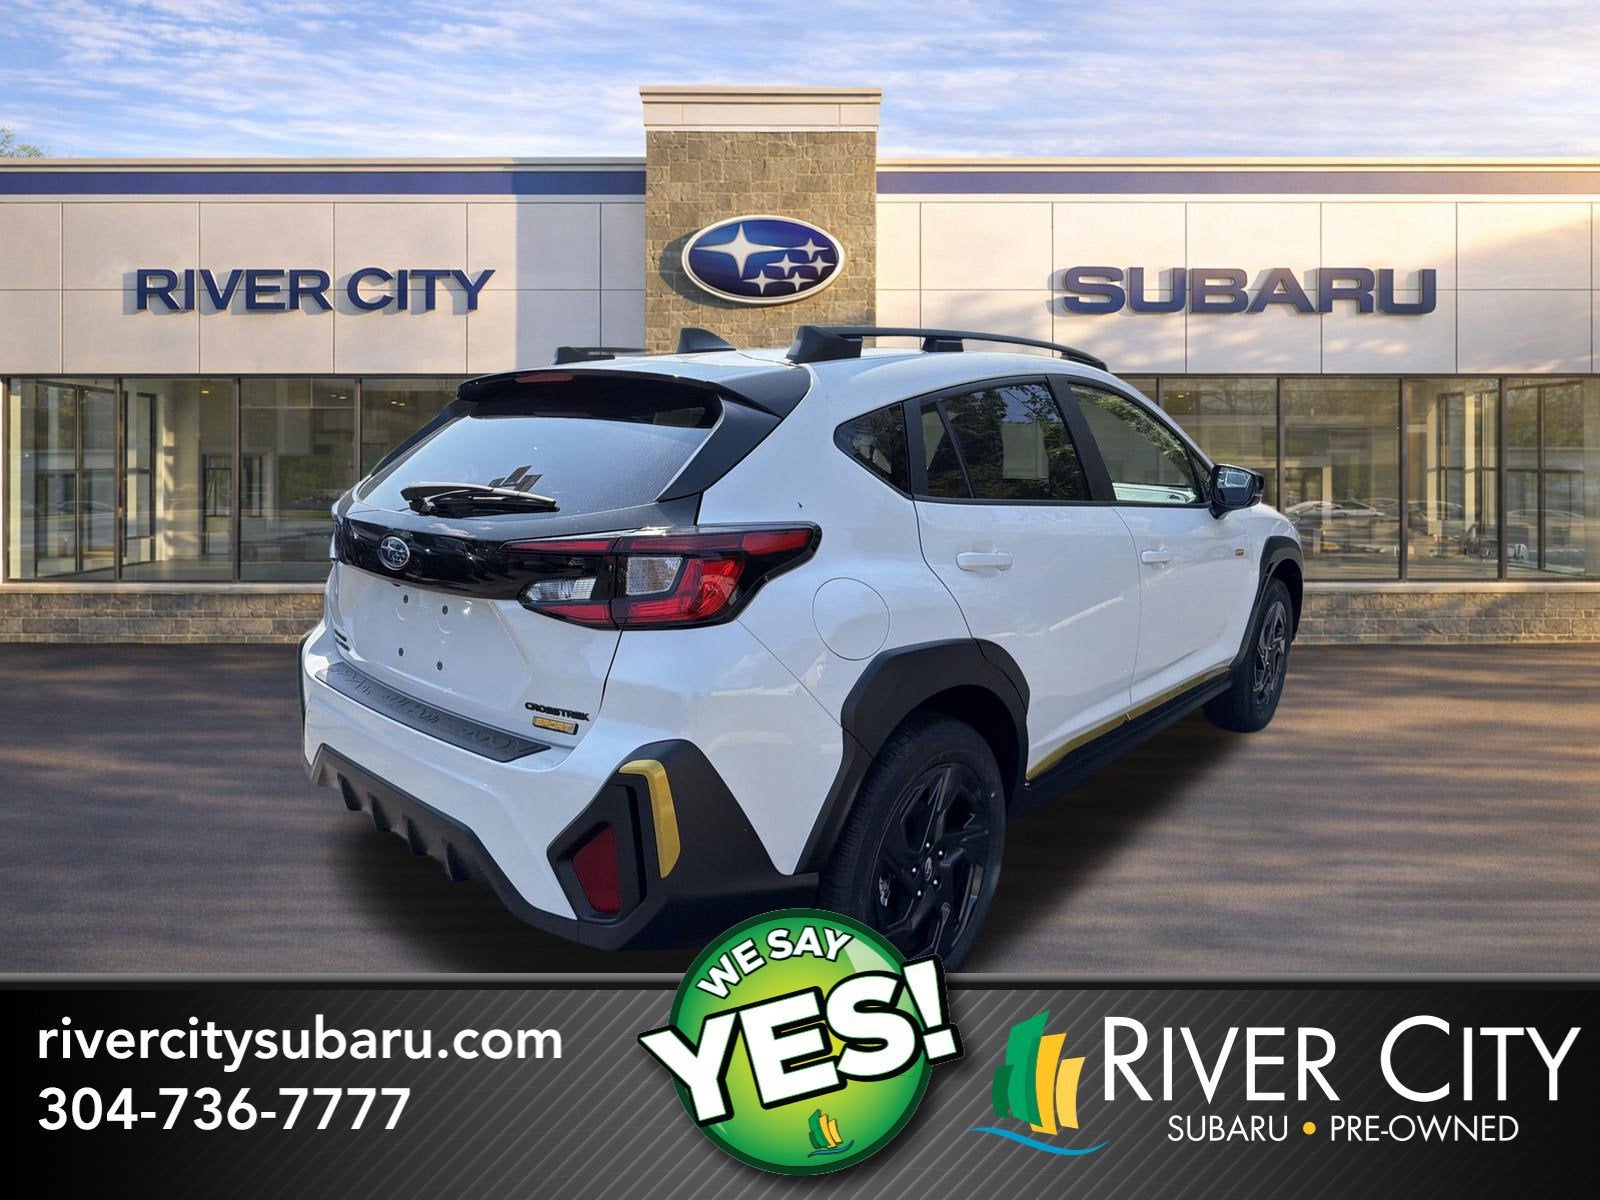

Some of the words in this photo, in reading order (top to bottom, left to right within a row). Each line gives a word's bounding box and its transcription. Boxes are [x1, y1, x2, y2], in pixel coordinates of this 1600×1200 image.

[136, 268, 334, 311] RIVER
[346, 266, 496, 311] CITY
[1063, 265, 1437, 315] SUBARU
[524, 701, 590, 722] CROSSTREK
